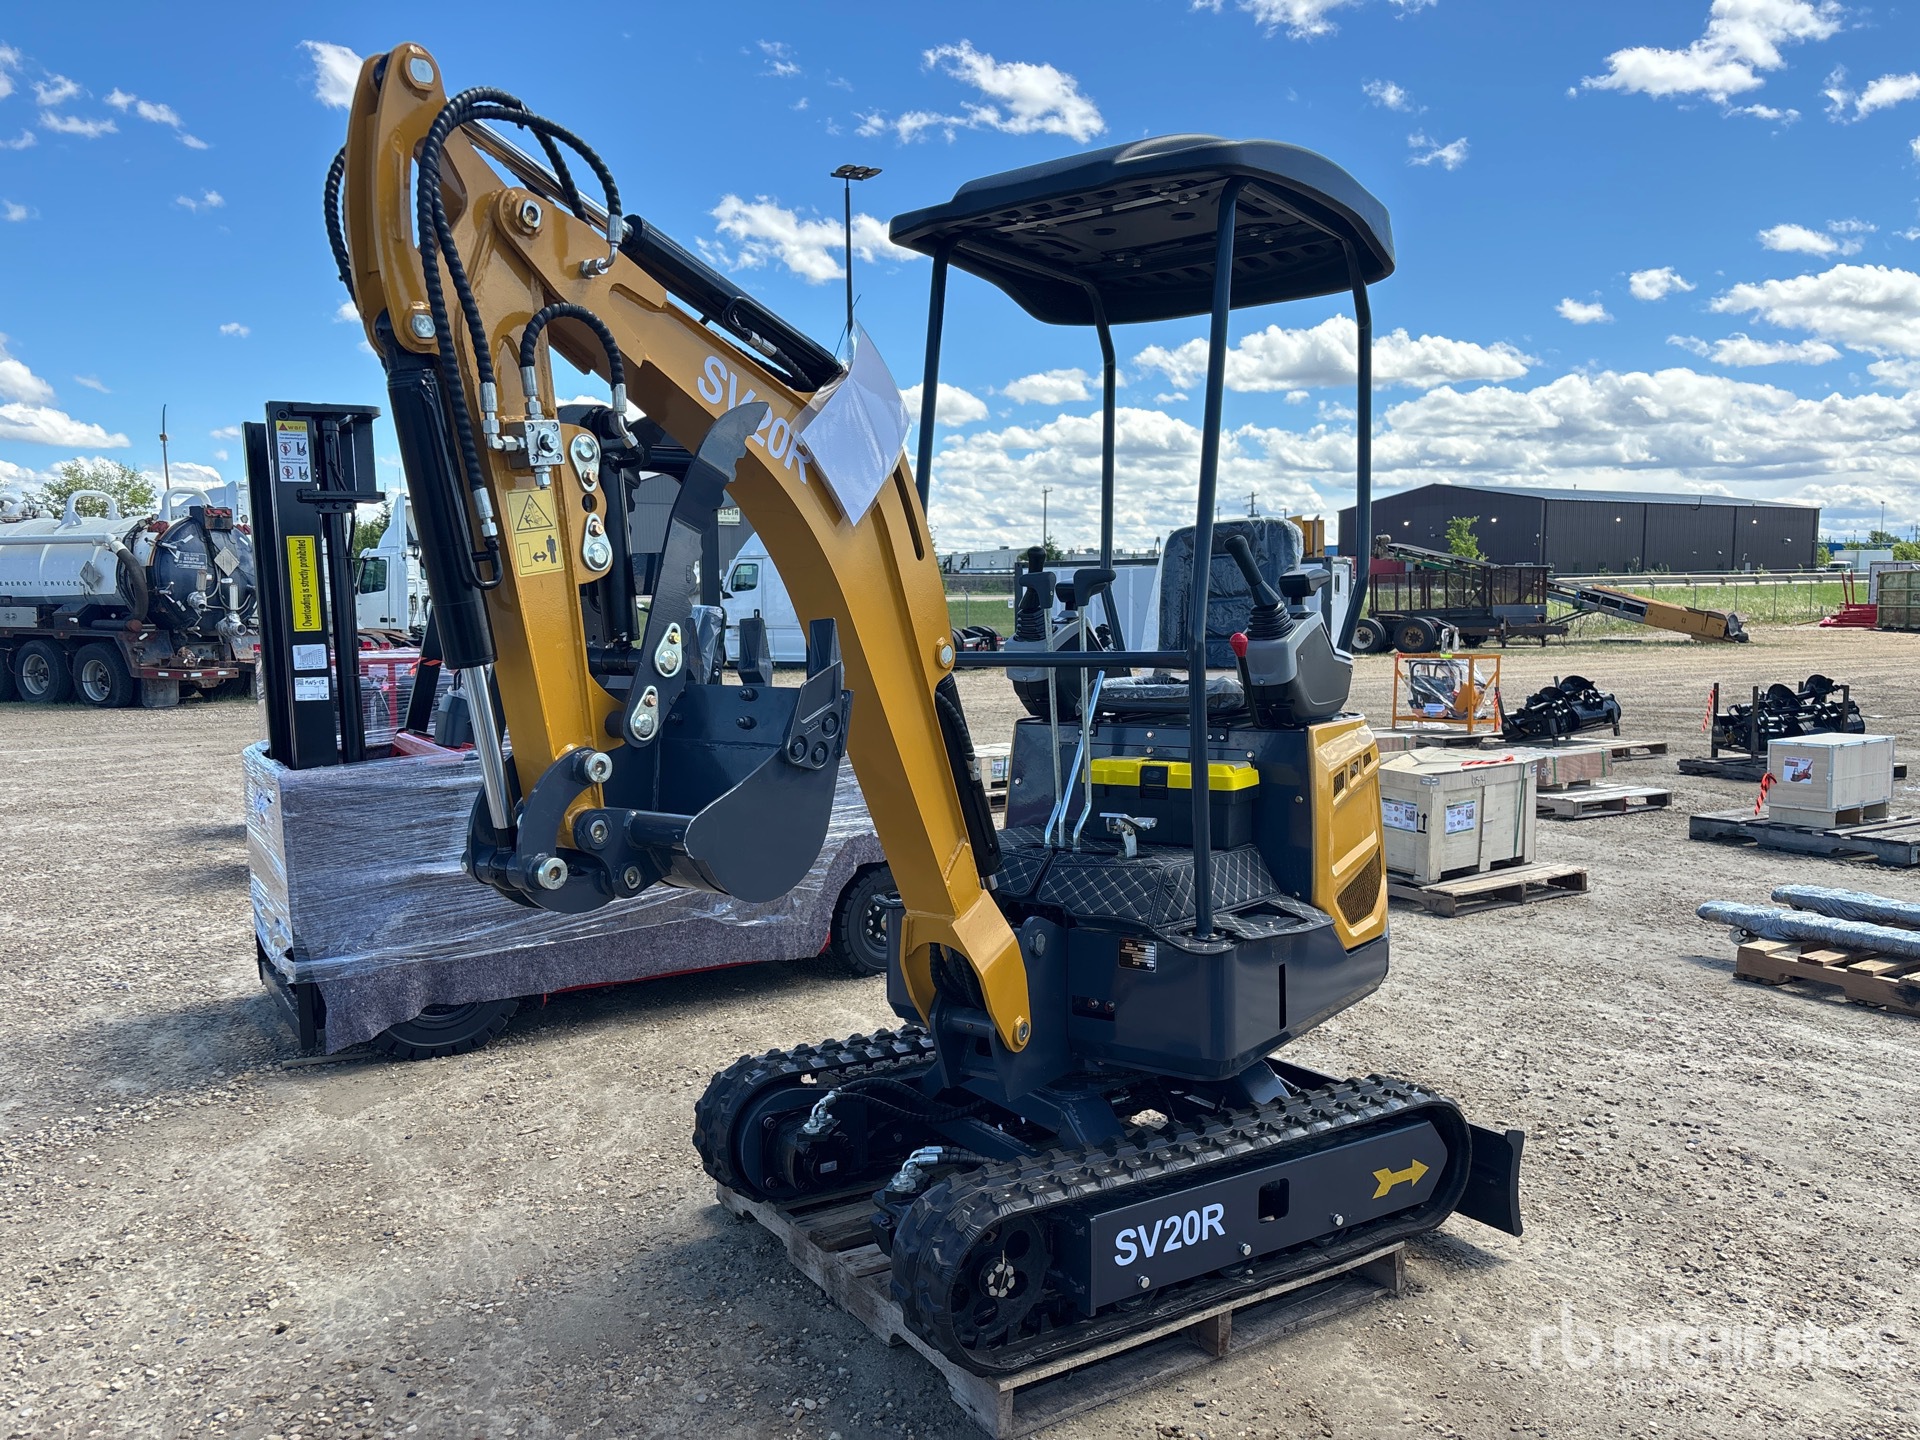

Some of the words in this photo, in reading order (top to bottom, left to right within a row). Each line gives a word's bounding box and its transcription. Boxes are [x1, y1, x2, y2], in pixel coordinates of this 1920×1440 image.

[295, 539, 310, 567] prohibited
[298, 569, 311, 588] strictly
[301, 594, 313, 627] Overloading
[1114, 1203, 1226, 1267] SV20R
